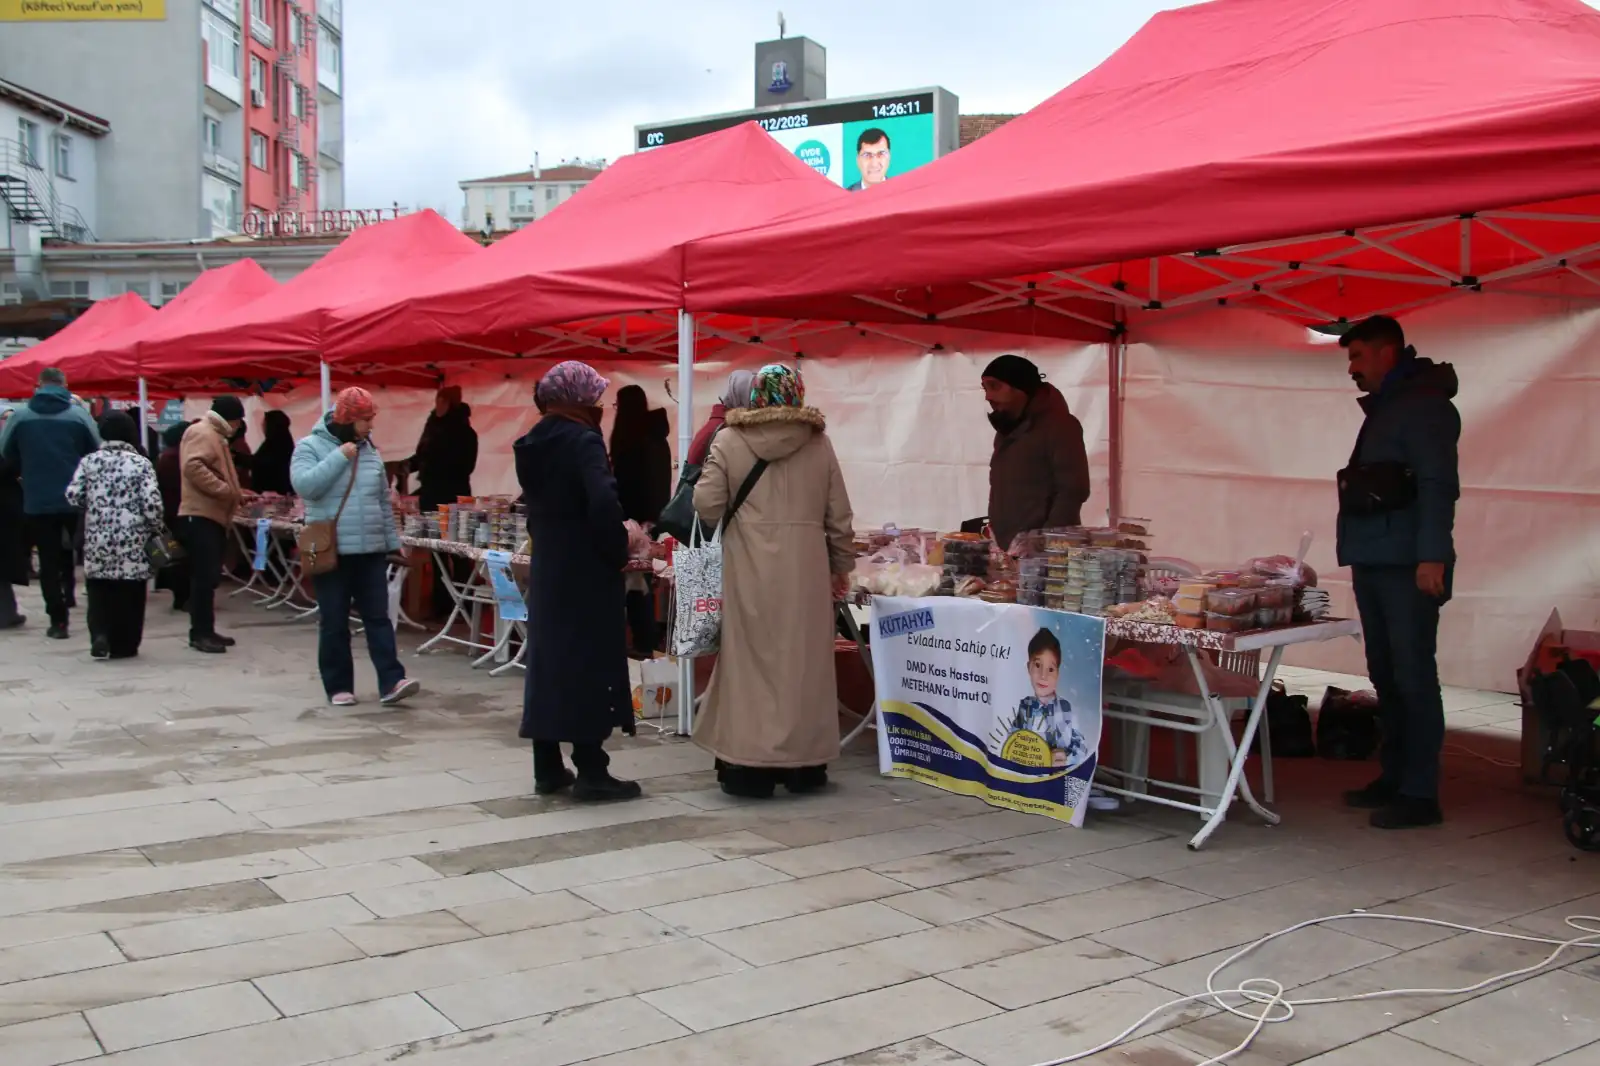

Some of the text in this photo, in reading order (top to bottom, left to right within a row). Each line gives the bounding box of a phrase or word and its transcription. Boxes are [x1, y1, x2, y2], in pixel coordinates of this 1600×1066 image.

[872, 100, 920, 117] 14:26:11
[756, 114, 808, 131] /12/2025
[243, 210, 314, 237] OTEL
[879, 611, 934, 635] KÜTAHYA
[907, 632, 952, 650] Evladına
[954, 639, 987, 658] Sahip
[906, 660, 988, 685] DMD Kas Hastası
[901, 677, 950, 697] METEHAN'a
[952, 687, 979, 702] Umut
[1030, 744, 1041, 753] No
